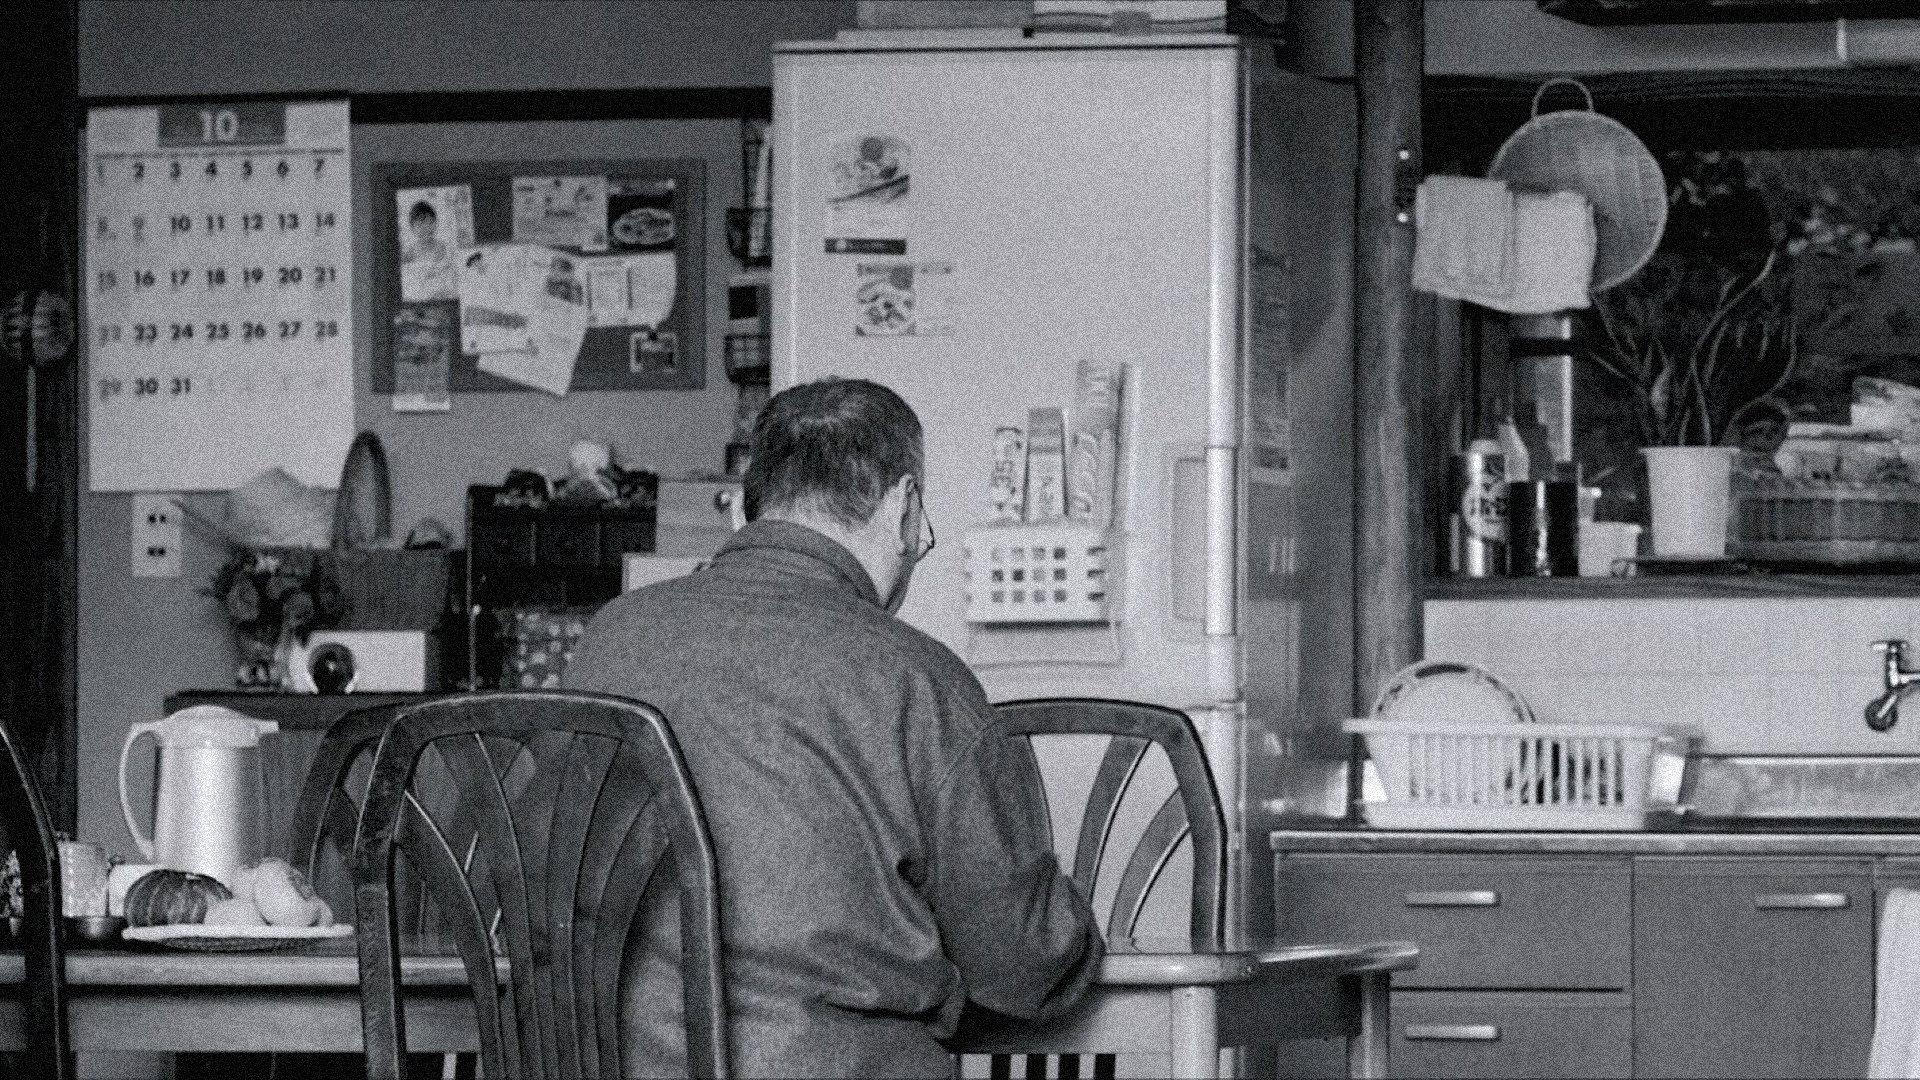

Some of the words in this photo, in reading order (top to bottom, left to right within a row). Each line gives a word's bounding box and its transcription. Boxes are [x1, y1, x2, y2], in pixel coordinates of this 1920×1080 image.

[198, 110, 239, 141] 10
[133, 162, 145, 178] 2
[170, 161, 182, 178] 3
[205, 160, 218, 177] 4
[241, 160, 253, 177] 5
[277, 160, 289, 177] 6
[313, 159, 324, 174] 7
[170, 216, 192, 232] 10
[206, 215, 225, 231] 11
[242, 214, 264, 231] 12
[278, 213, 300, 230] 13
[315, 213, 336, 228] 14
[134, 270, 155, 287] 16
[170, 270, 190, 285] 17
[206, 269, 226, 285] 18
[242, 268, 264, 284] 19
[278, 267, 303, 284] 20
[314, 266, 336, 282] 21
[134, 325, 157, 341] 23
[170, 324, 194, 340] 24
[206, 324, 229, 339] 25
[242, 323, 267, 339] 26
[278, 322, 302, 338] 27
[314, 321, 339, 337] 28
[135, 379, 159, 395] 30
[170, 379, 191, 394] 31
